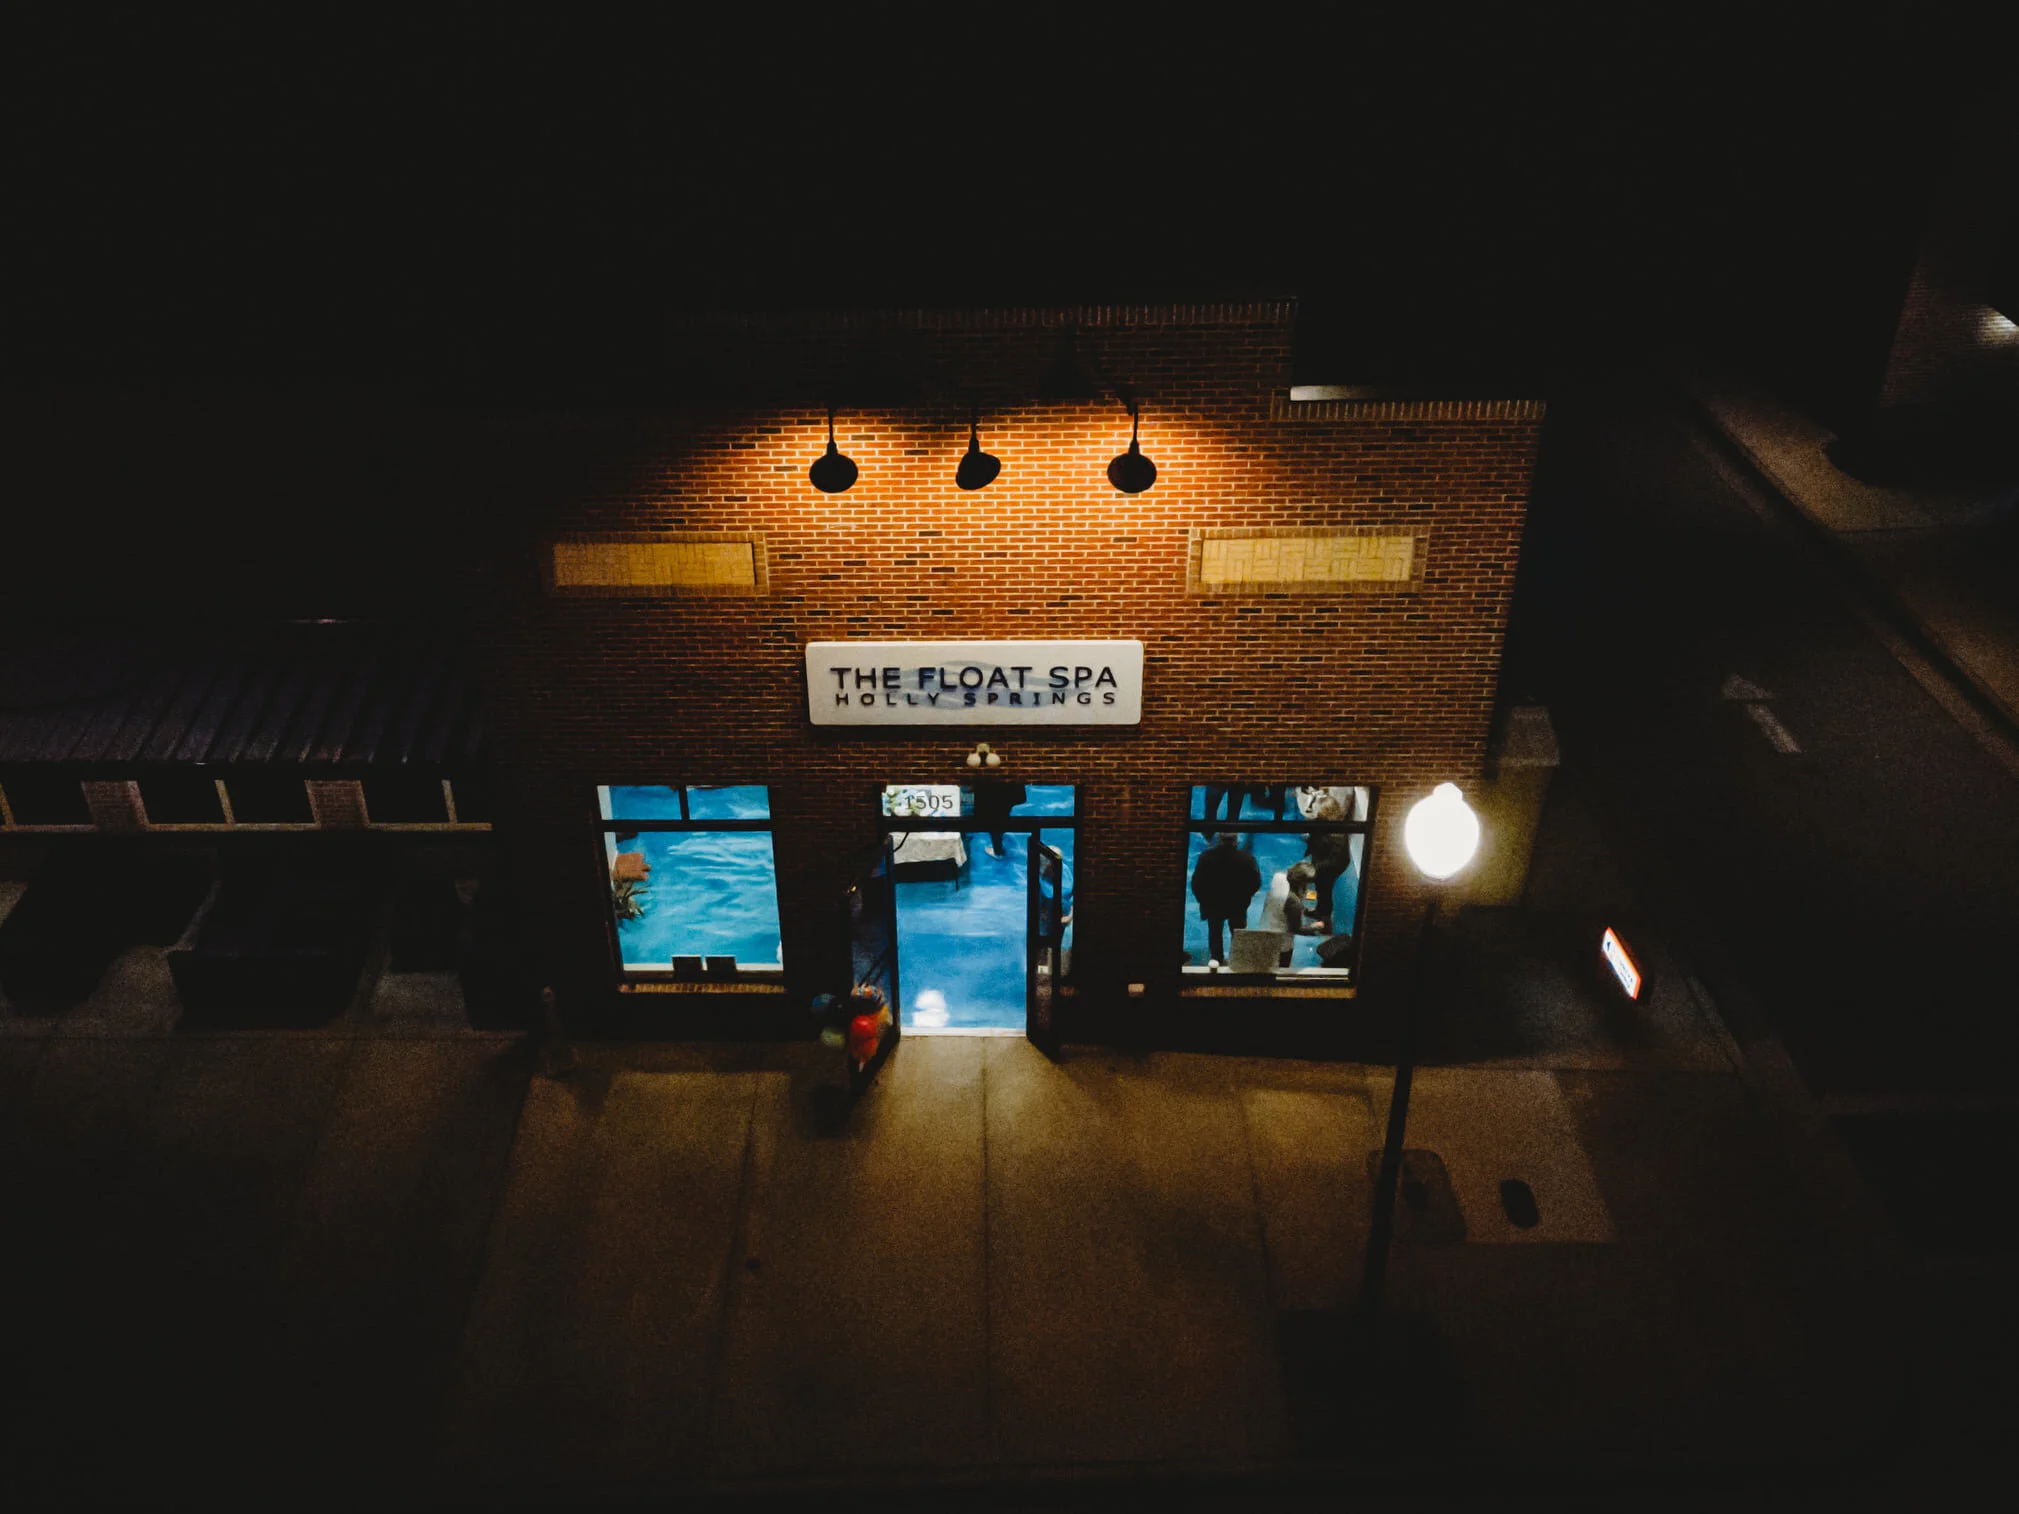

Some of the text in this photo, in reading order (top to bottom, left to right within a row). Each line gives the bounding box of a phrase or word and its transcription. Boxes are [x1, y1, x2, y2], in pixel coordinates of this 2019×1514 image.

[830, 666, 1118, 690] THE FLOAT SPA
[835, 691, 1116, 706] HOLLY SPRINGS
[905, 794, 954, 811] 1505
